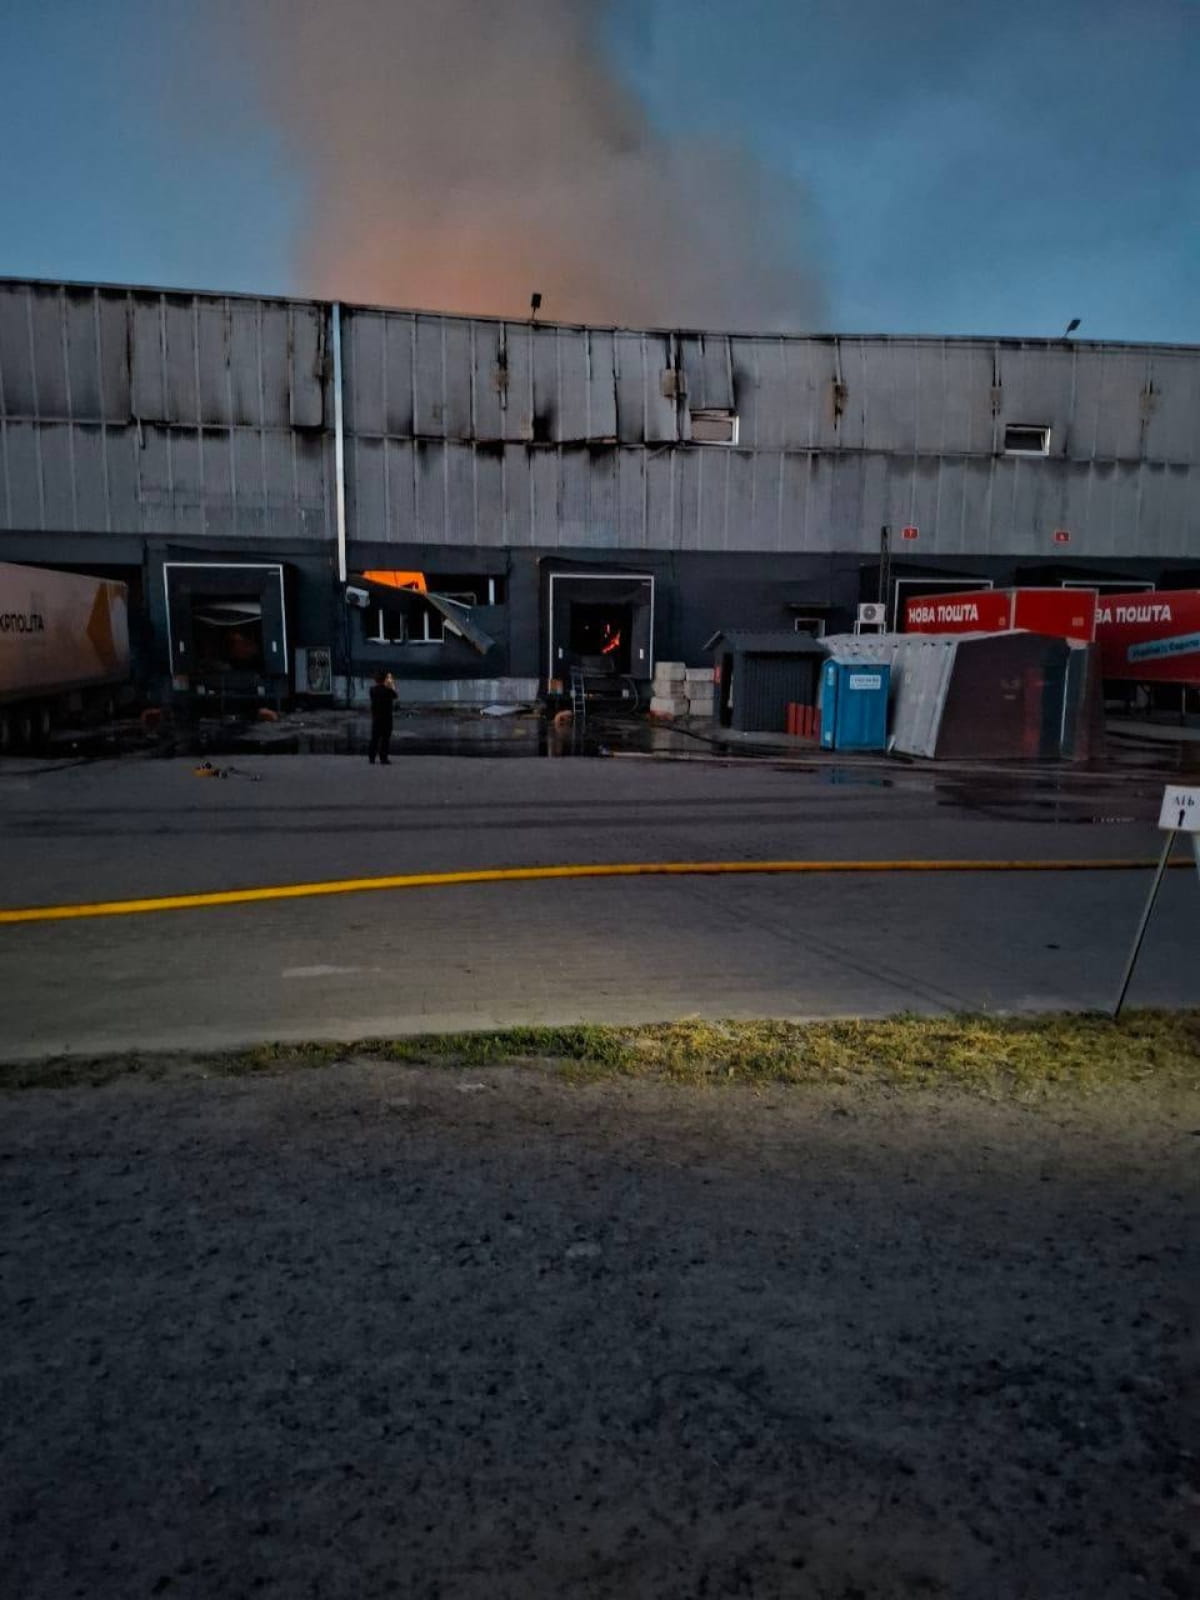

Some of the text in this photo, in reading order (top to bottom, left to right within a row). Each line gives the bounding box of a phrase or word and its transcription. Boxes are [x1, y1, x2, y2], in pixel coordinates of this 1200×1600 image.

[0, 613, 44, 633] КРПОШТА
[908, 603, 979, 624] НОВА ПОШТА
[1095, 604, 1172, 624] ВА ПОШТА
